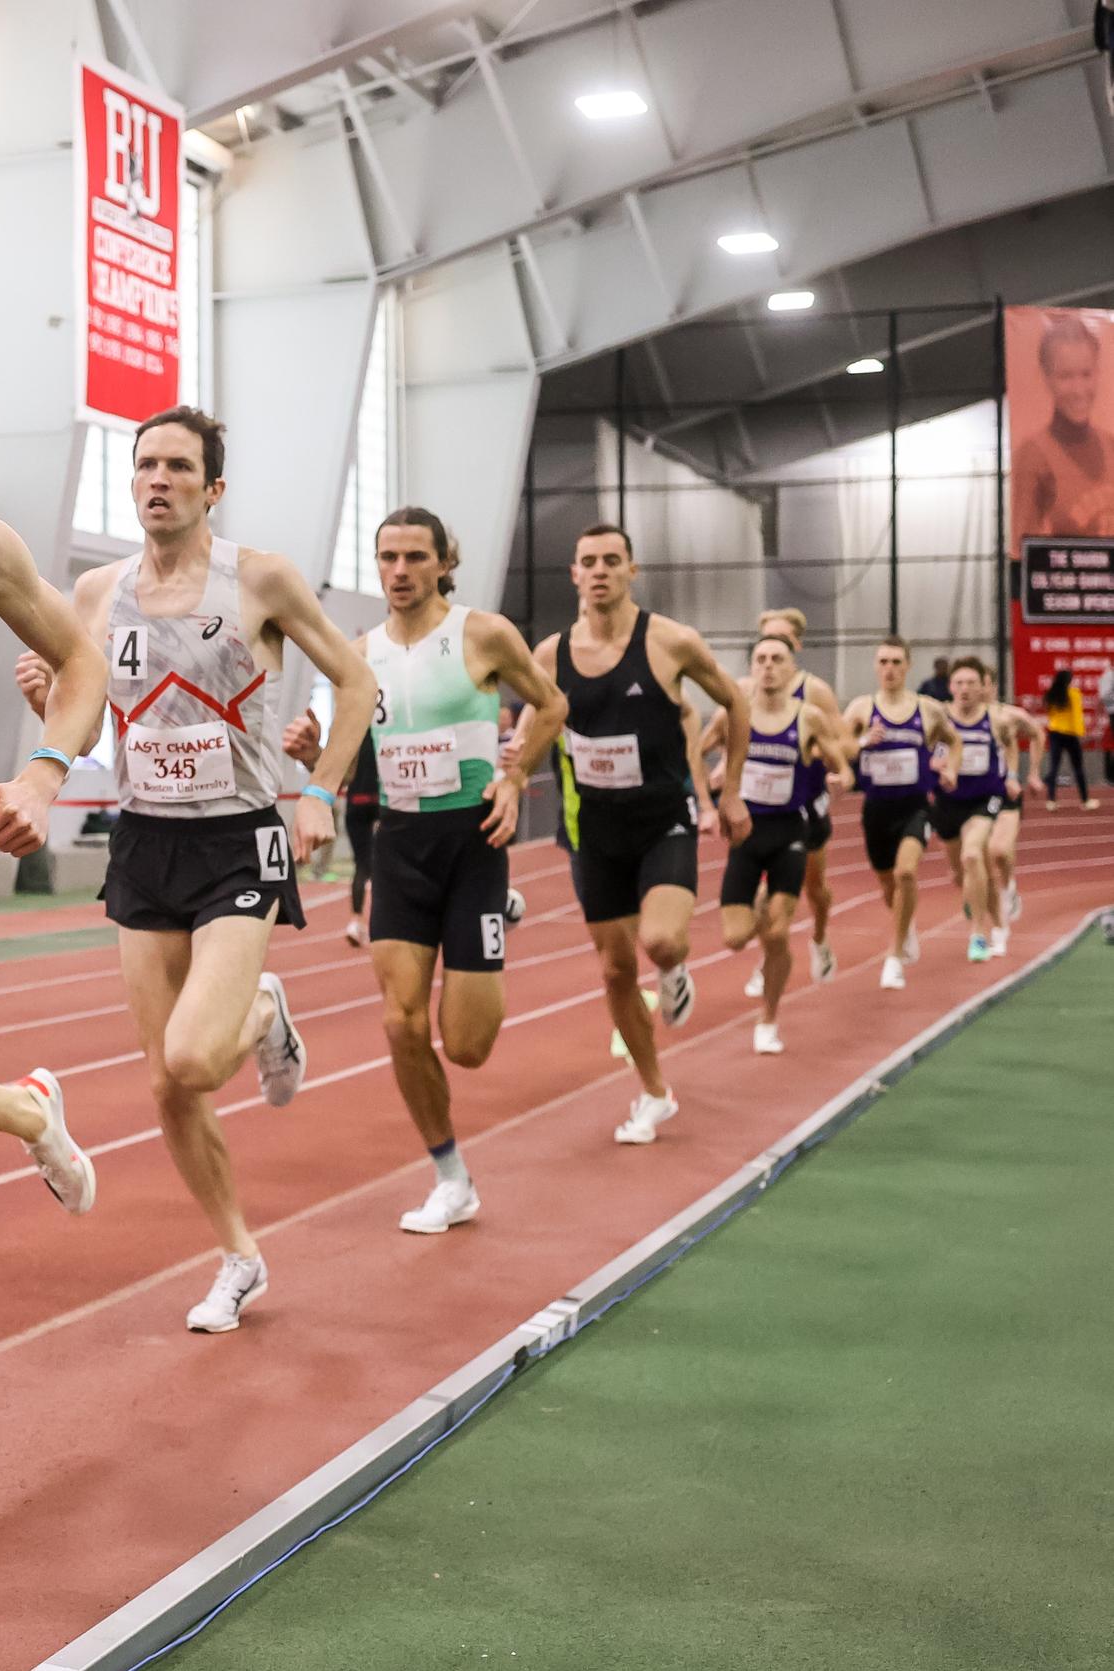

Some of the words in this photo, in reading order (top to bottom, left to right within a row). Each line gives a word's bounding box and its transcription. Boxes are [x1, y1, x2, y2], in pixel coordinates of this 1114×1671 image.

[102, 86, 162, 220] BU
[118, 630, 141, 677] 4
[128, 739, 164, 754] LAST
[167, 737, 225, 754] CHANCE
[380, 745, 402, 758] AST
[406, 743, 453, 757] CHANCE
[154, 758, 197, 779] 345
[398, 760, 427, 779] 571
[176, 779, 229, 793] University
[267, 830, 285, 877] 4
[489, 918, 501, 954] 3
